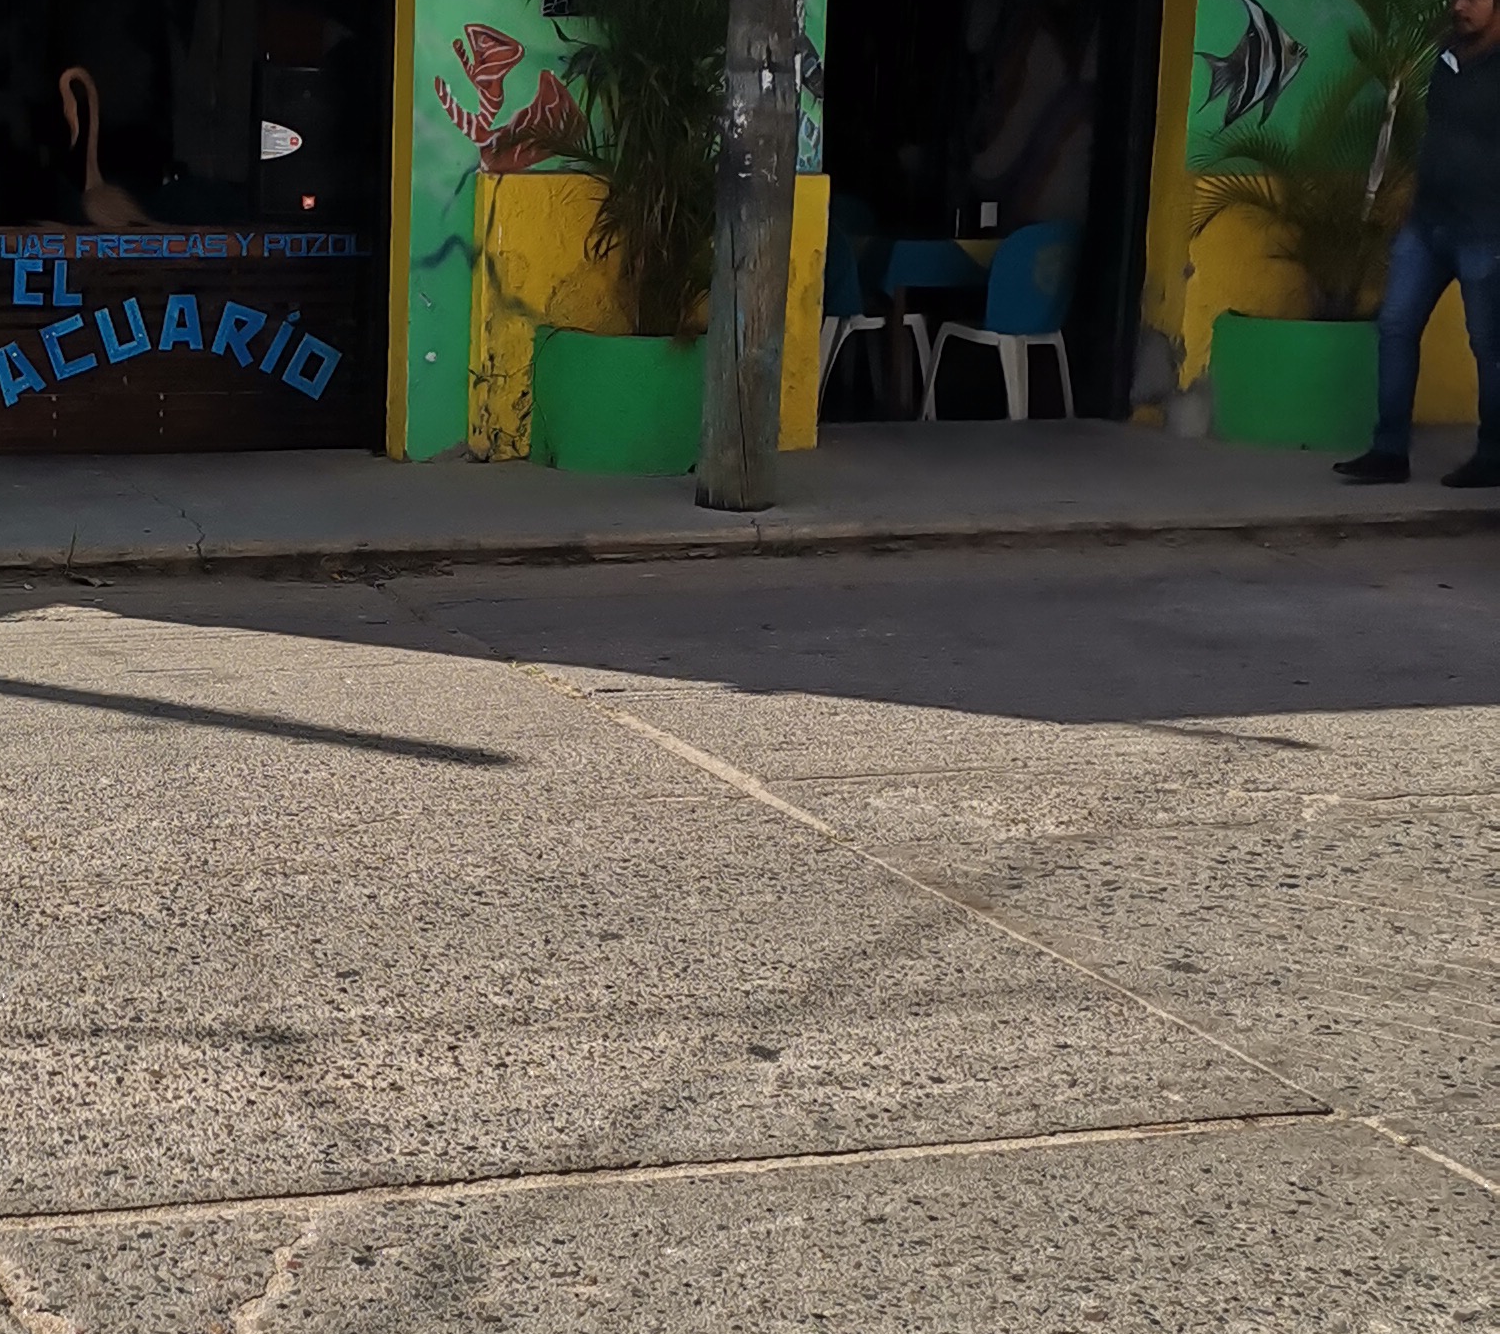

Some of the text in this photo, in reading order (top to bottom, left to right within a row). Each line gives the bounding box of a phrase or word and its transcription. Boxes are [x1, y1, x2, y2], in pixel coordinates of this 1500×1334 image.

[75, 234, 229, 259] FRESCAS
[235, 232, 256, 257] Y
[12, 258, 83, 307] EL
